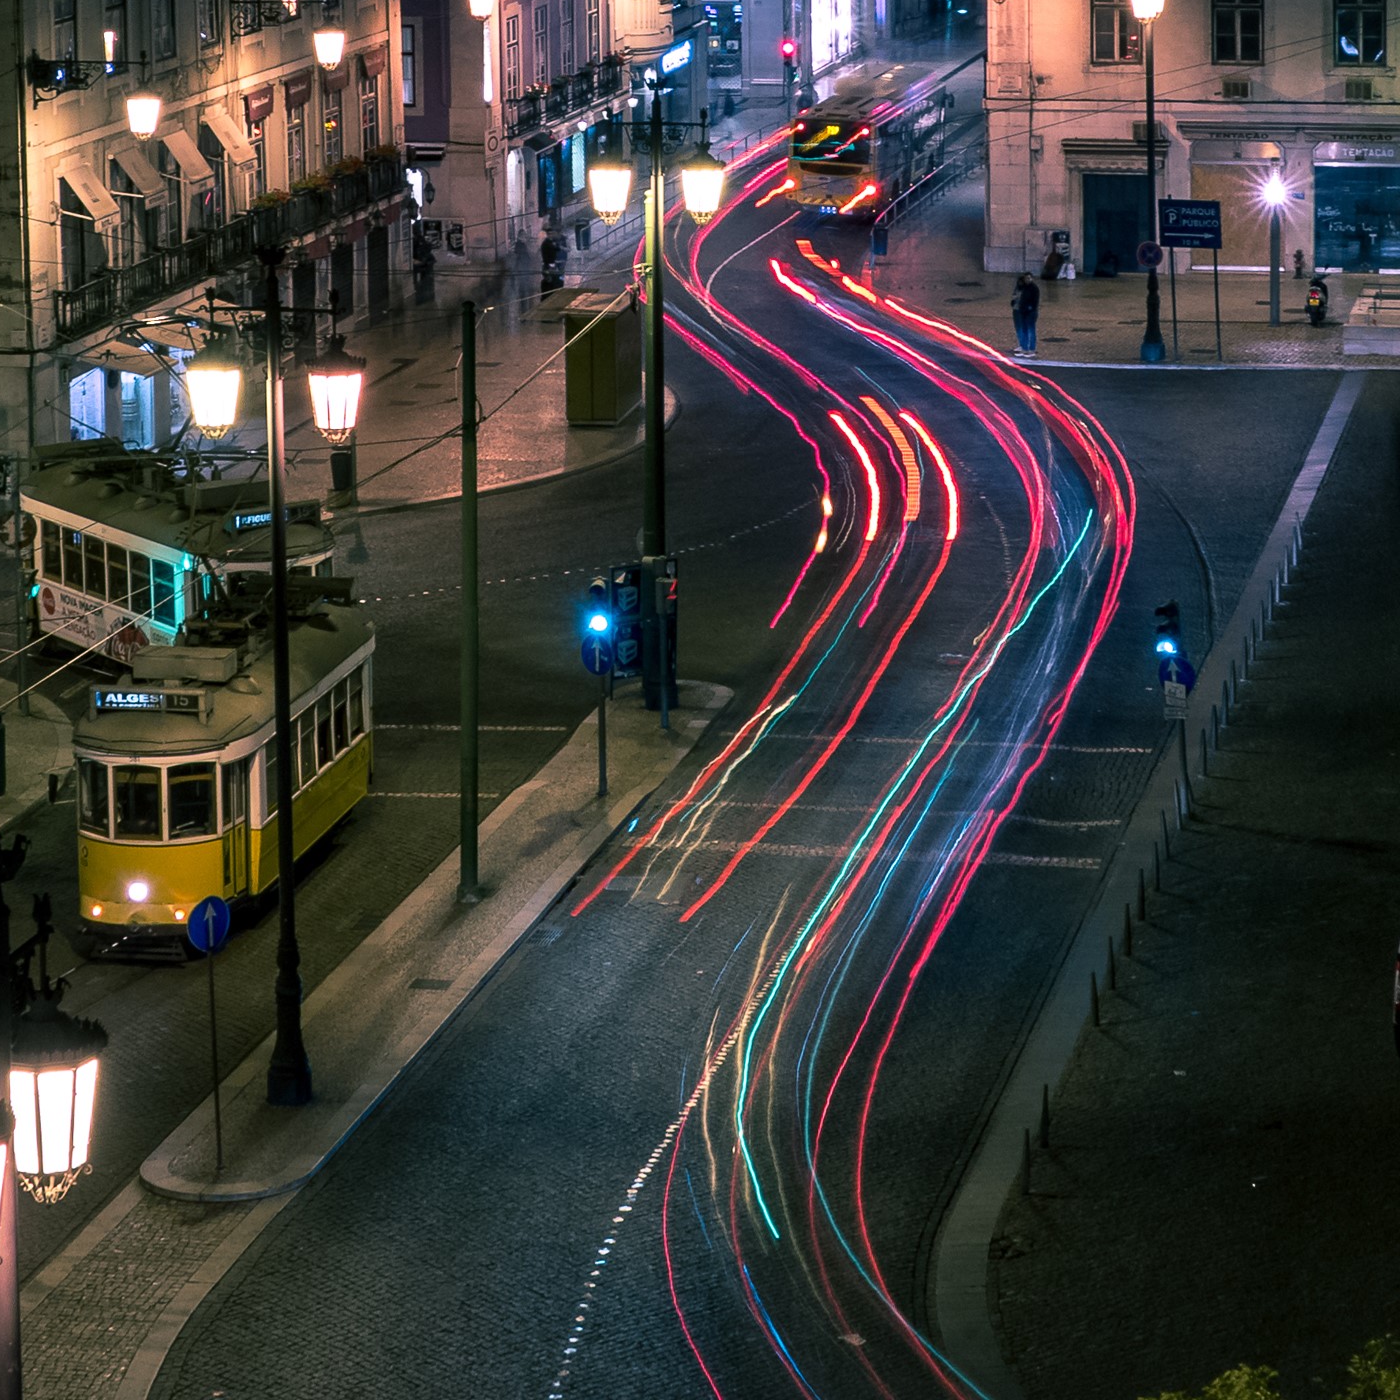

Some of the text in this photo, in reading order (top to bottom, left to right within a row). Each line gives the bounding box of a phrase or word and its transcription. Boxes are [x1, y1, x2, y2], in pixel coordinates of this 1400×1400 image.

[1208, 131, 1269, 140] TENTAÇÃO
[1331, 133, 1393, 142] TENTAÇÃO
[1181, 207, 1217, 216] PARQUE
[1182, 217, 1220, 228] PÚBLICO
[173, 695, 189, 707] 15
